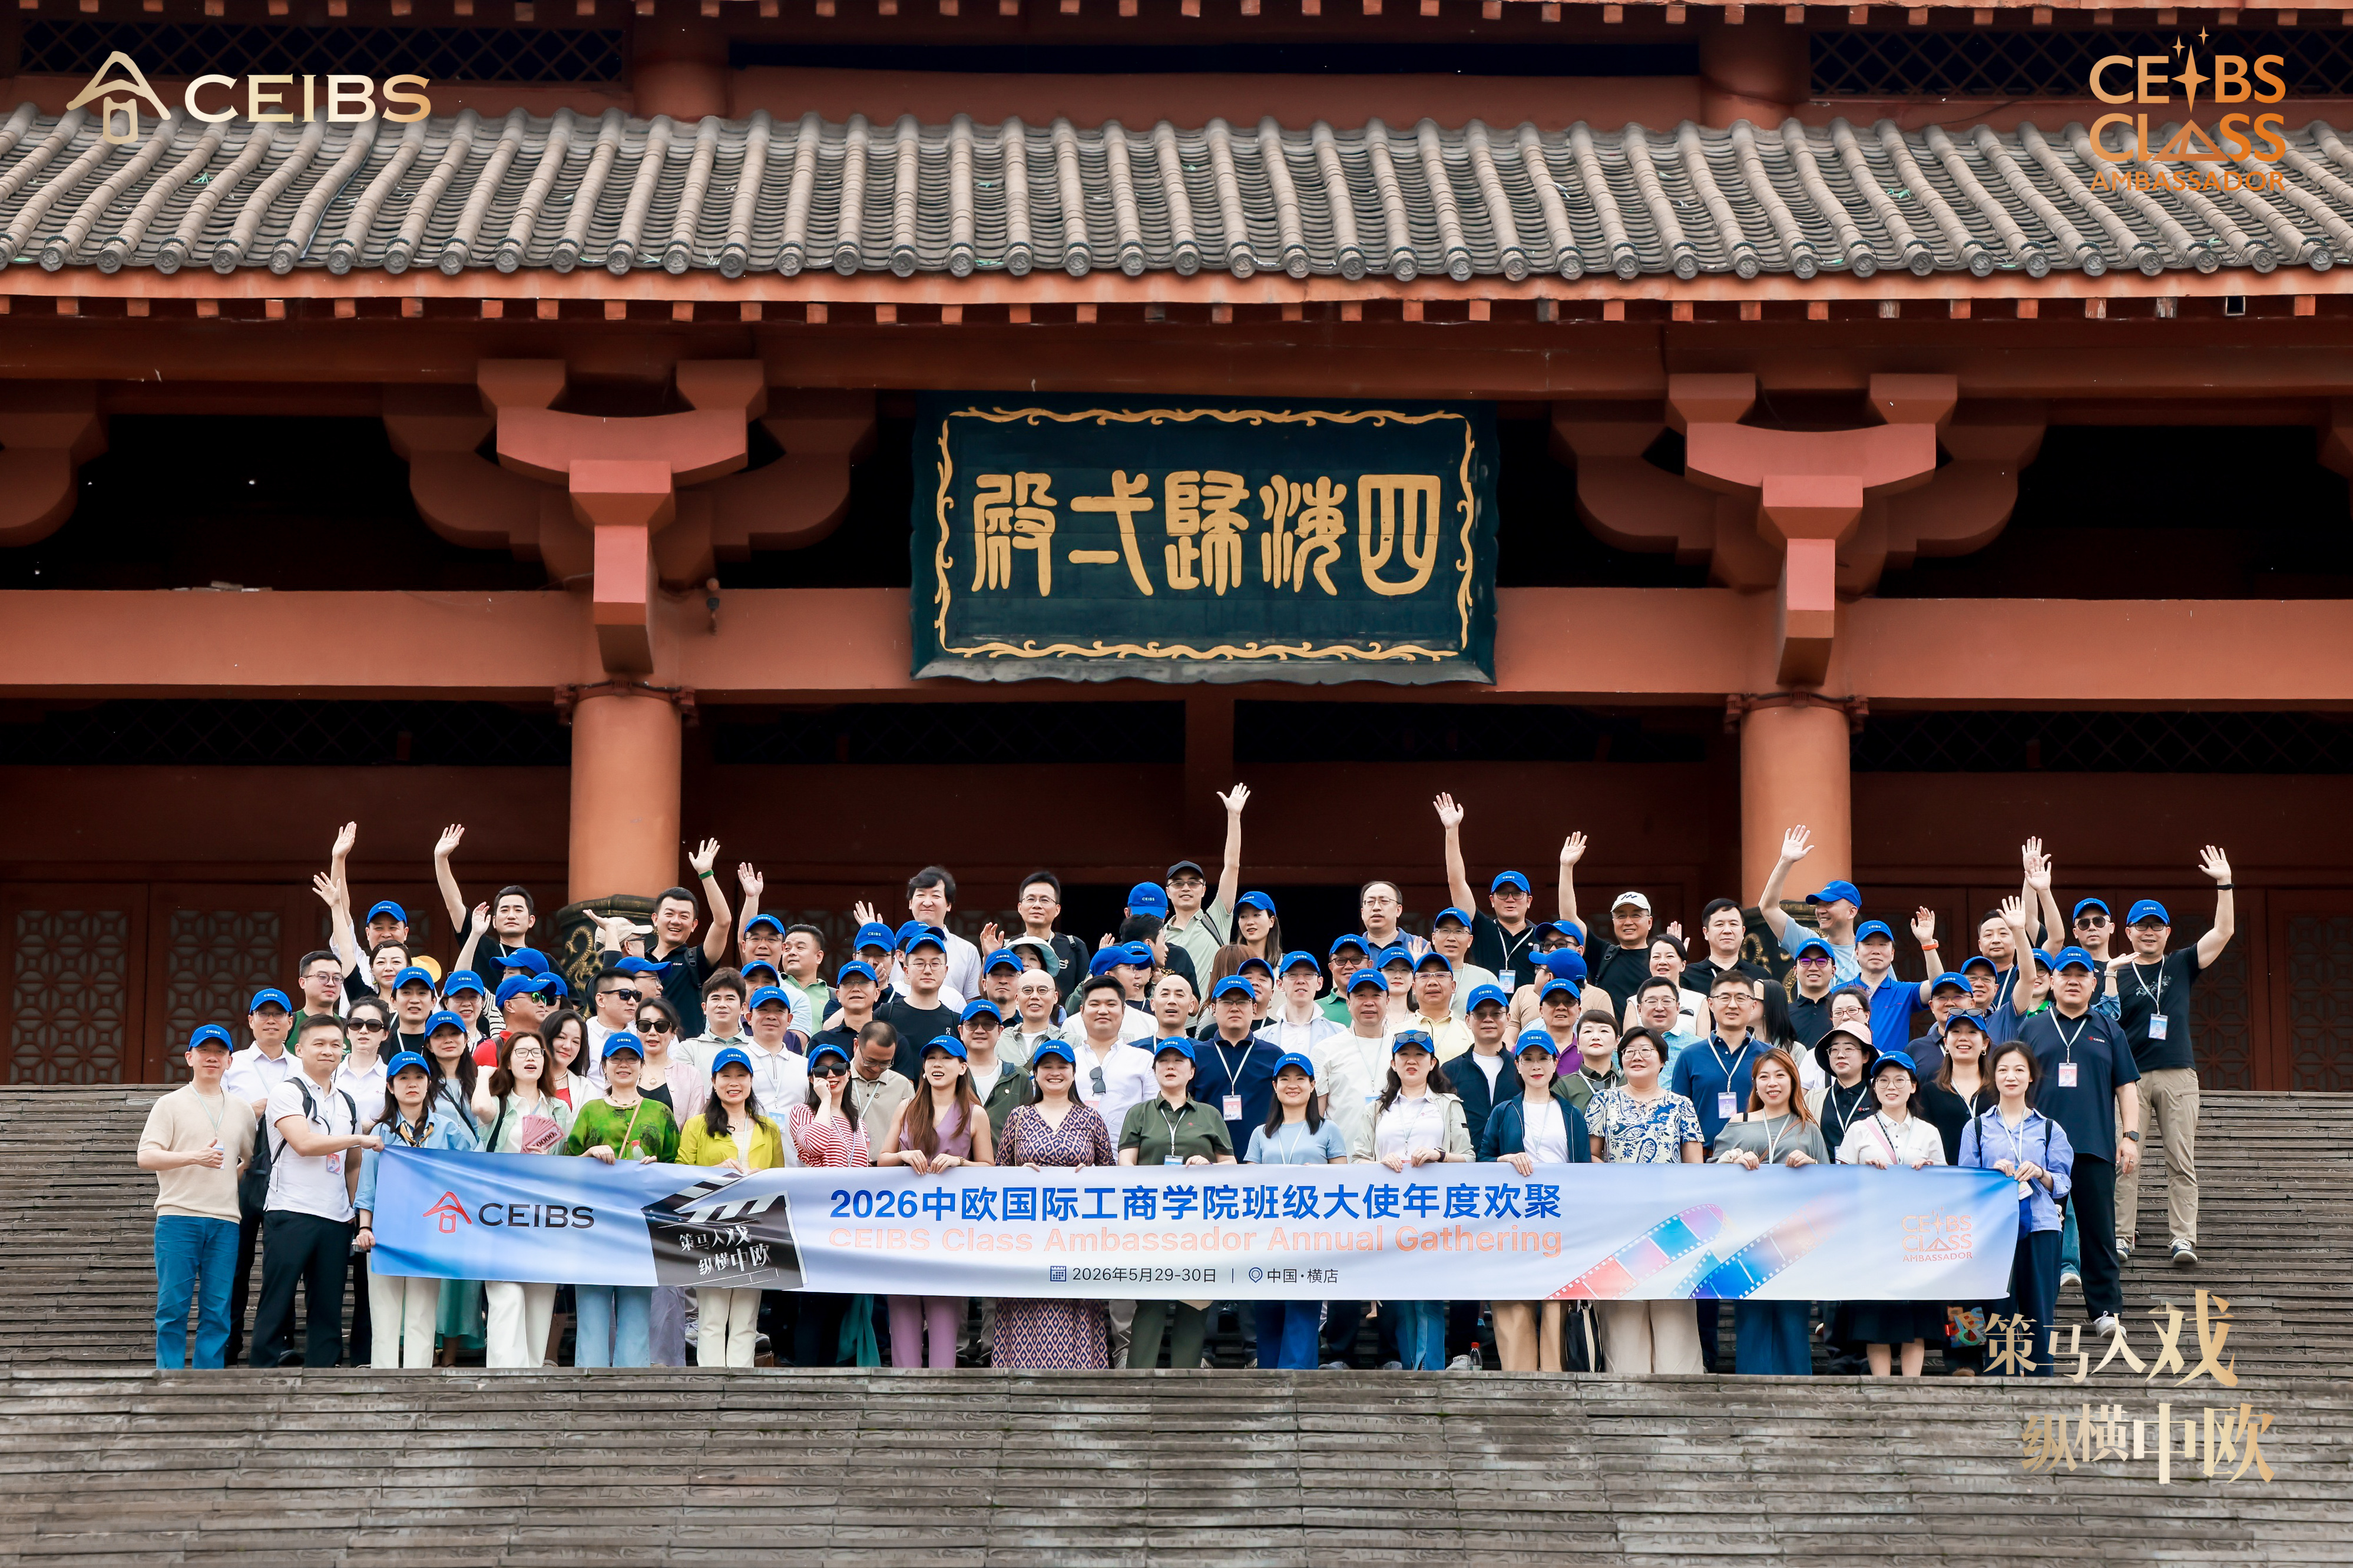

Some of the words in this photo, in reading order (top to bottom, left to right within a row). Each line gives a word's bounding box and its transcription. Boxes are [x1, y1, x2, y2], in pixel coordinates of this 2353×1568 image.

[830, 1182, 1562, 1222] 2026中欧国际工商学院班级大使年度欢聚
[478, 1202, 594, 1229] CEIBS
[829, 1228, 930, 1251] CEIBS
[942, 1226, 1032, 1251] Class
[1044, 1226, 1257, 1252] Ambassador
[1267, 1225, 1383, 1251] Annual
[1395, 1225, 1561, 1258] Gathering
[1902, 1234, 1973, 1252] CLASS
[698, 1243, 771, 1276] 纵横中欧
[1902, 1251, 1973, 1262] AMBASSADOR
[1072, 1267, 1216, 1282] 2026年5月29-30日
[1267, 1268, 1339, 1283] 中国·横店
